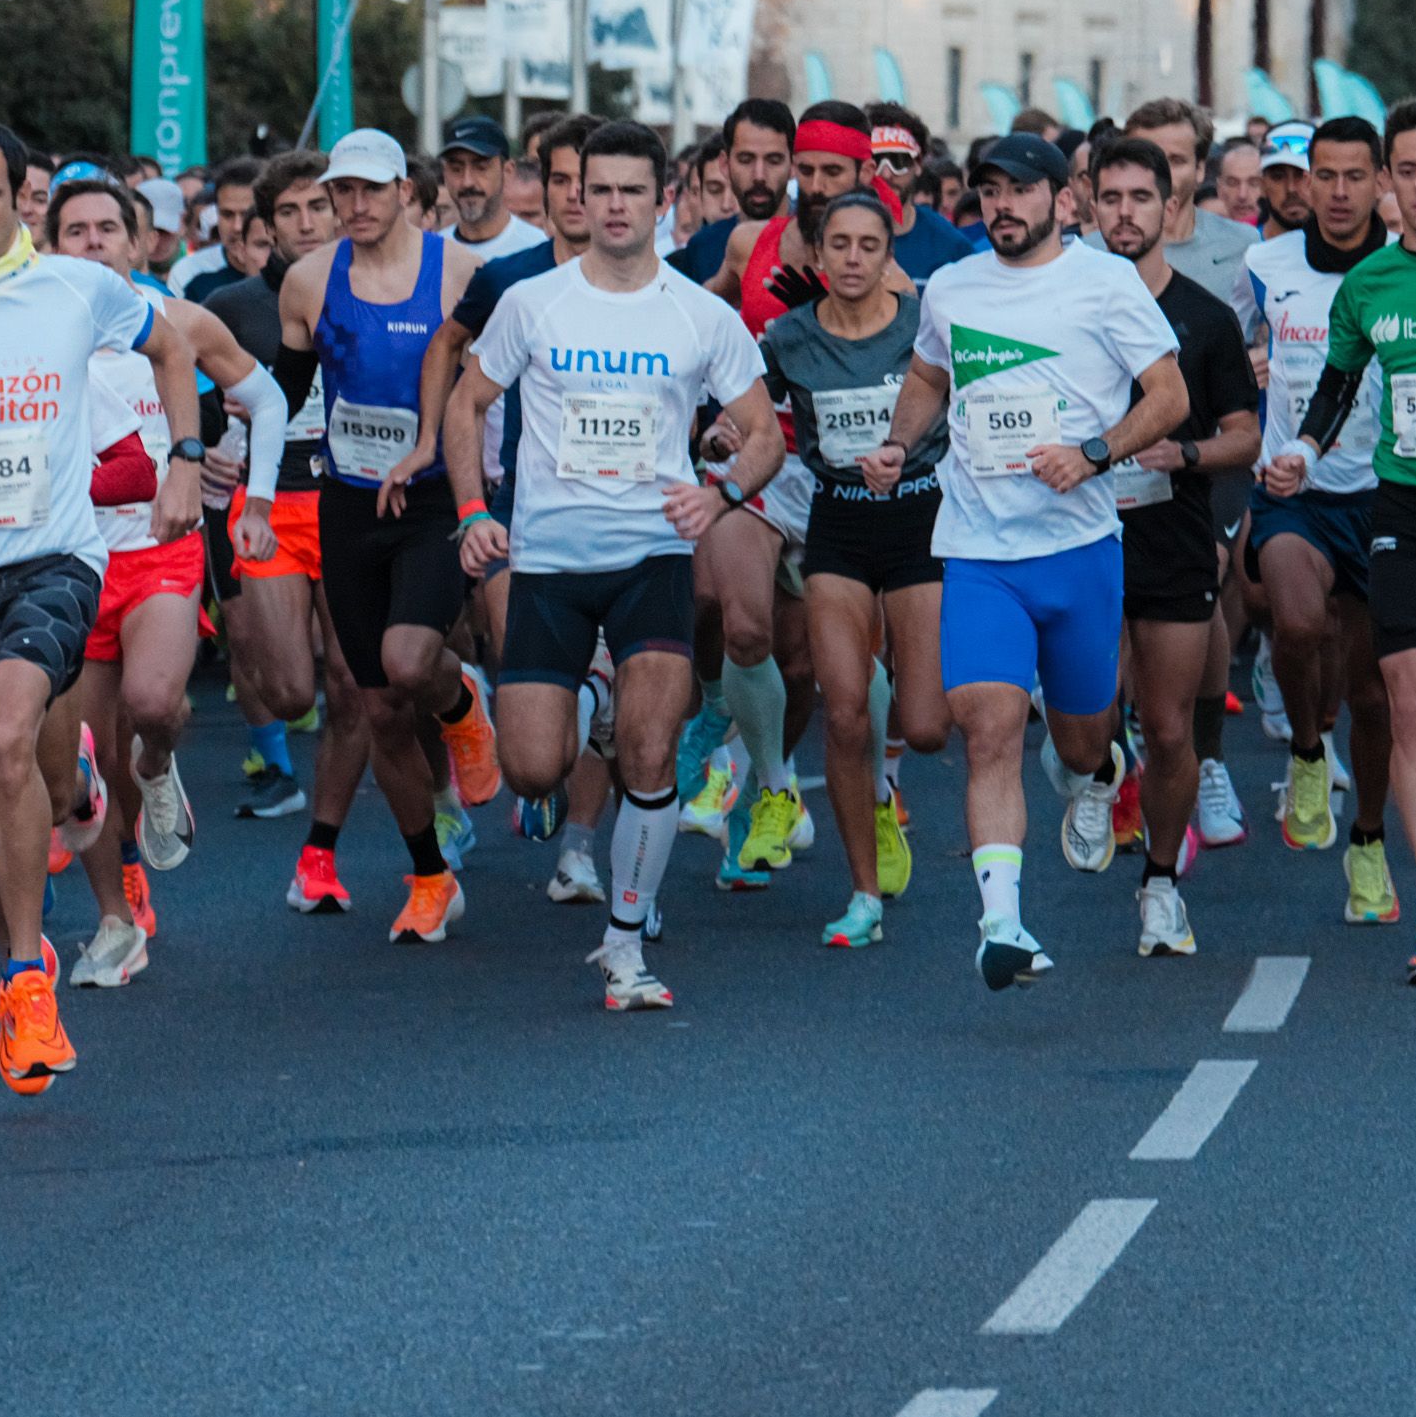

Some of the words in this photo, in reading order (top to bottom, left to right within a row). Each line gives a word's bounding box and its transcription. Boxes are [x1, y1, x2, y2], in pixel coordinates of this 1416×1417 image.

[386, 320, 428, 335] KIPRUN
[550, 347, 671, 377] unum
[590, 378, 629, 390] LEGAL
[578, 417, 641, 437] 11125
[824, 407, 891, 430] 28514
[988, 410, 1033, 431] 569
[340, 419, 406, 444] 15309
